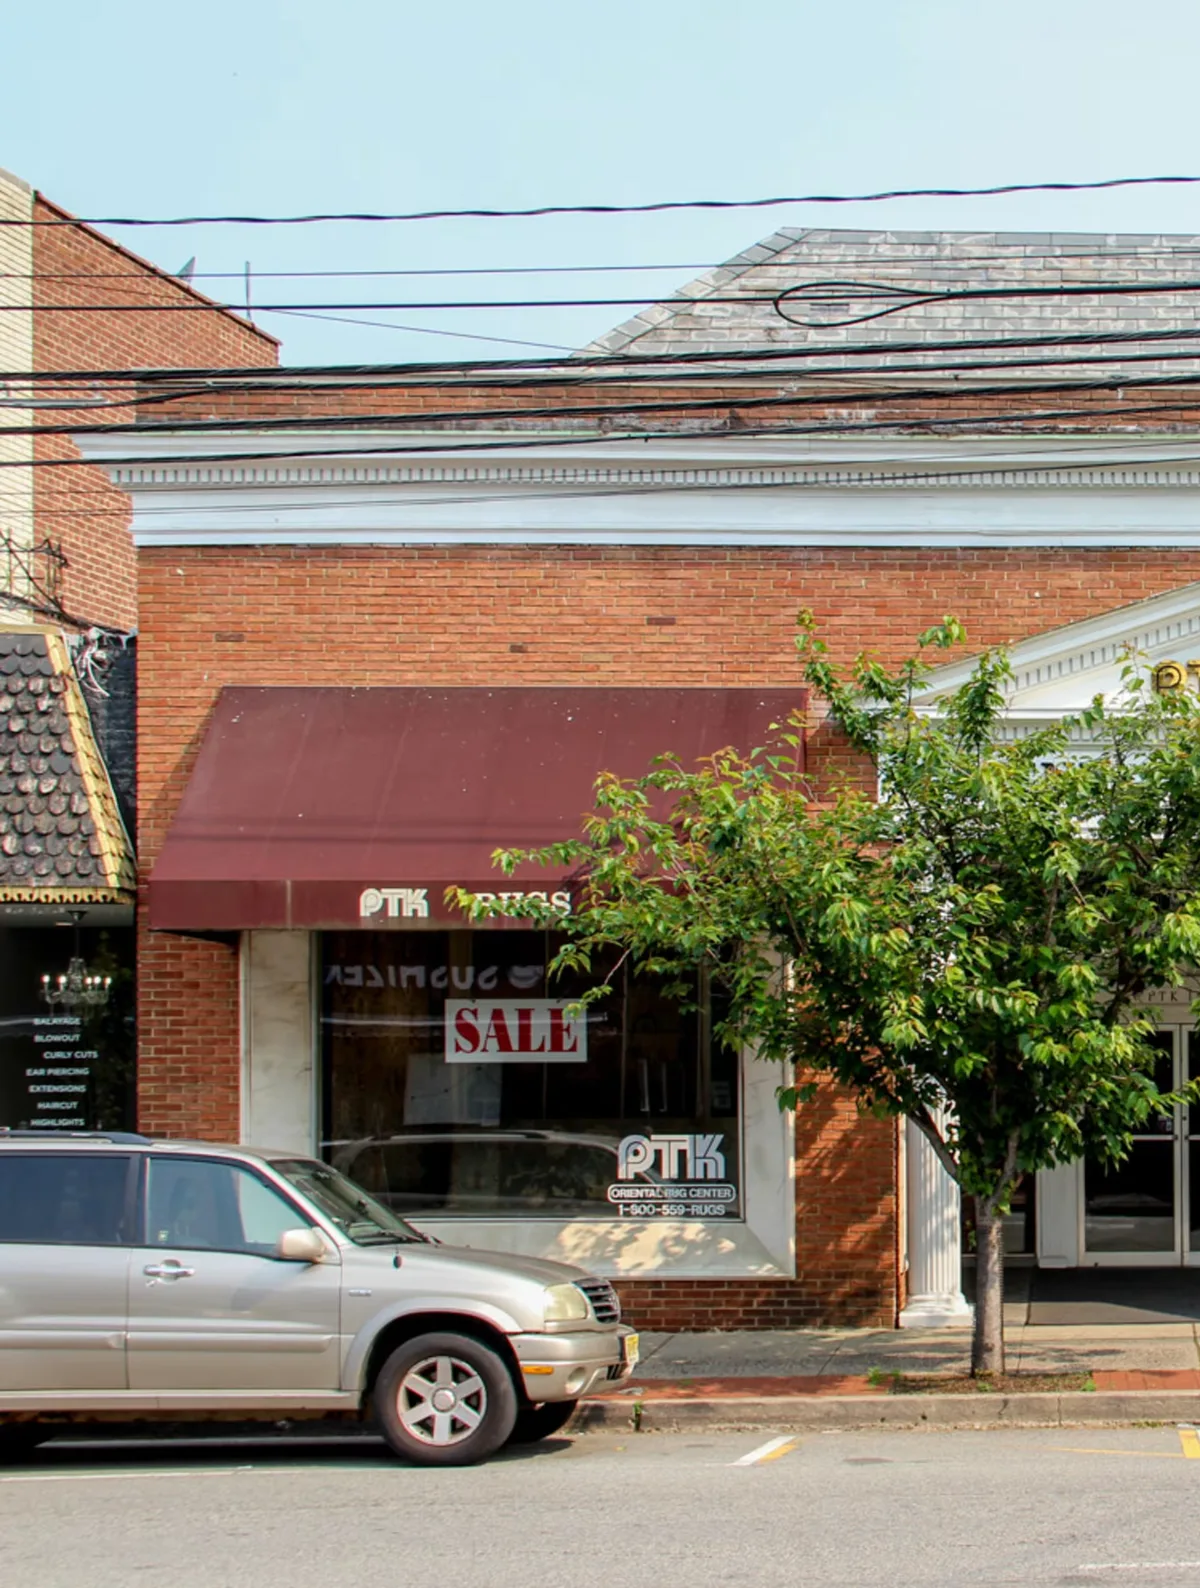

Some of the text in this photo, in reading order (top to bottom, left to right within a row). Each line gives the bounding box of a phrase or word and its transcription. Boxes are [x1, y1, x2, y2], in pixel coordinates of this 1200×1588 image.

[360, 888, 428, 917] PTK
[1148, 990, 1178, 1002] PTK
[454, 1007, 578, 1054] SALE
[34, 1034, 81, 1043] BLOWOUT
[43, 1050, 99, 1059] CURLY CUTS
[26, 1067, 90, 1076] EAR PIERCING
[28, 1084, 86, 1093] EXTENSIONS
[37, 1101, 78, 1110] HAIRCUT
[30, 1118, 85, 1127] HIGHLIGHTS
[617, 1134, 726, 1179] PTK
[610, 1187, 731, 1198] ORIENTAL RUG CENTER
[619, 1204, 726, 1216] 1-800-559-RUGS
